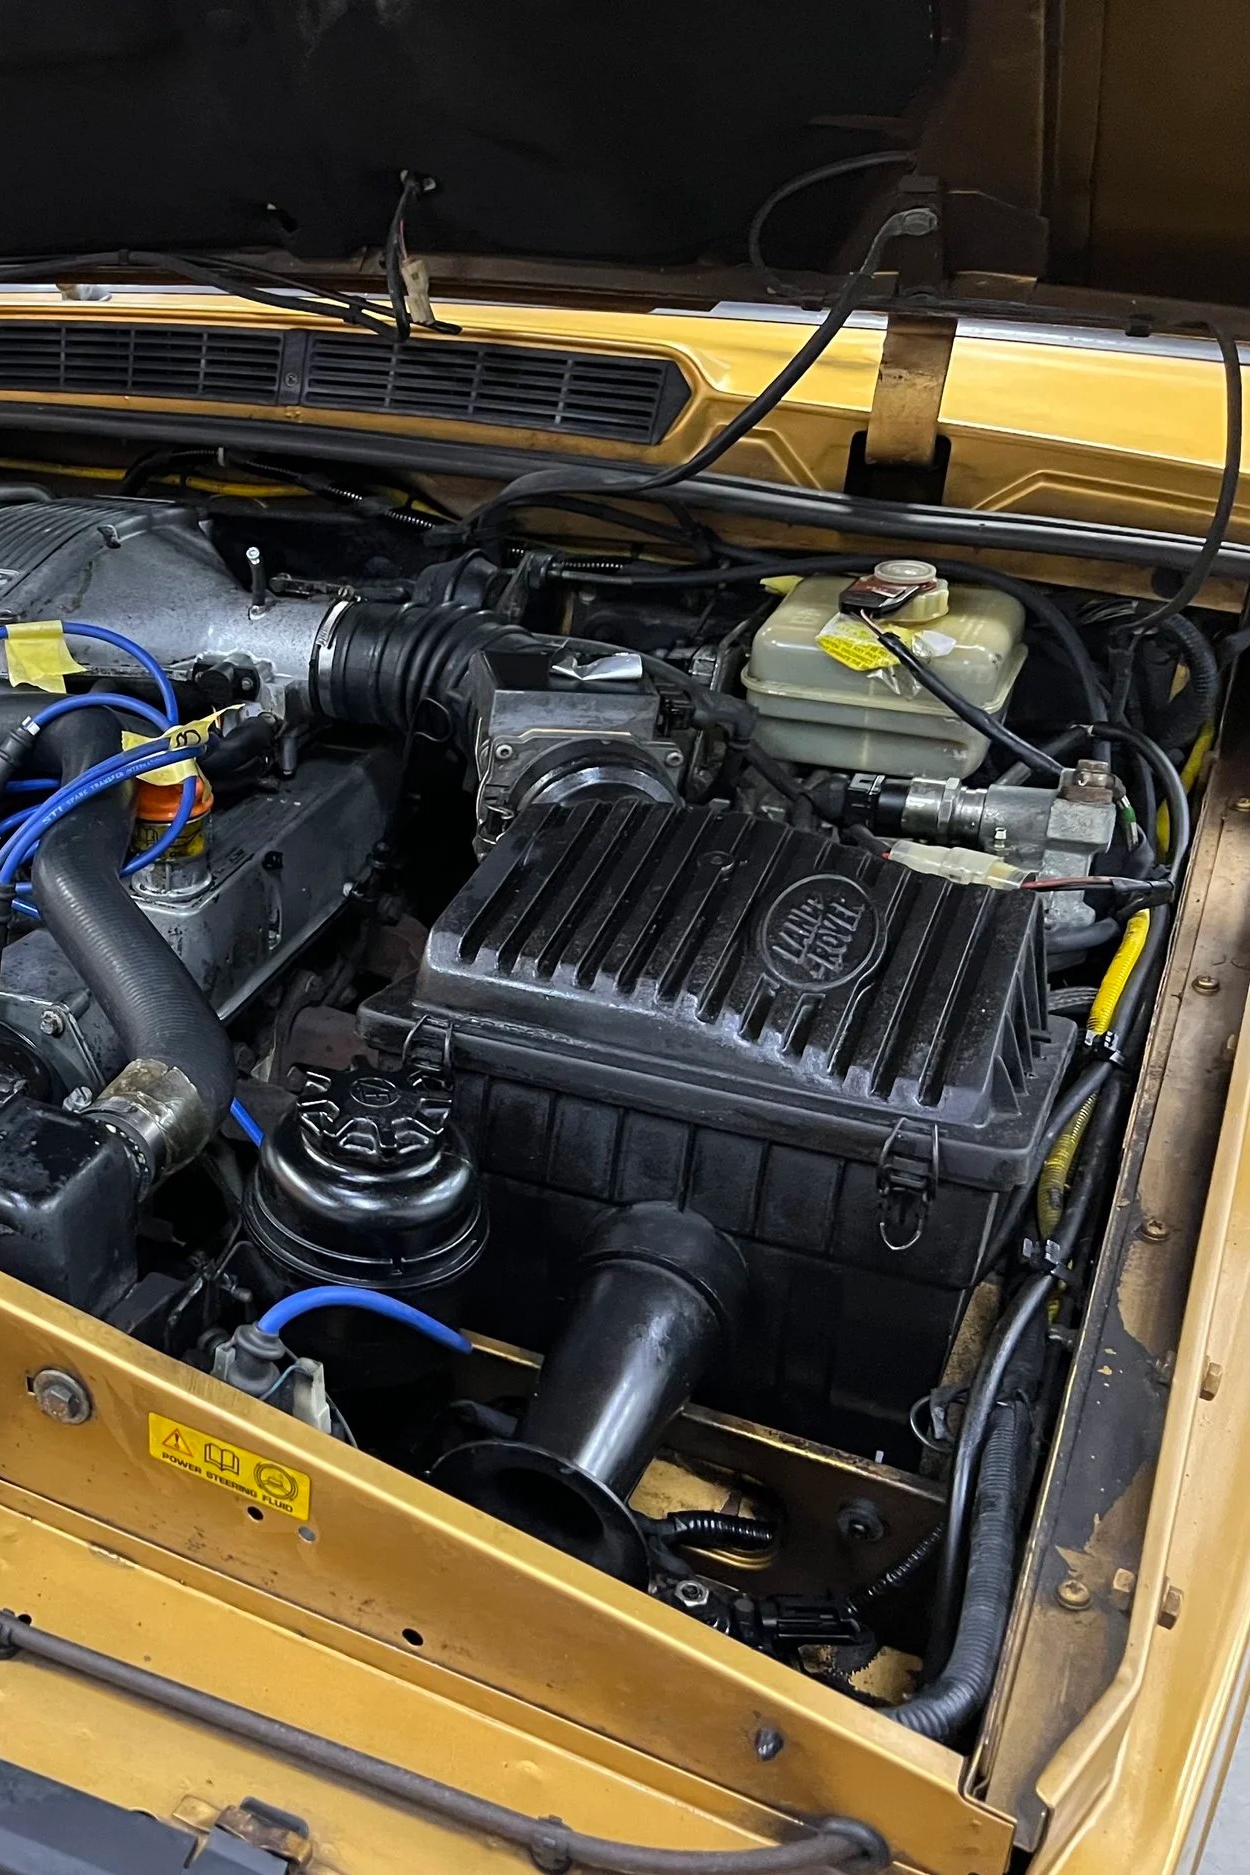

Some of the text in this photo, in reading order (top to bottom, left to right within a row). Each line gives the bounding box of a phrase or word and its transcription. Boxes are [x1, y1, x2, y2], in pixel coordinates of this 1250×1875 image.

[161, 1452, 293, 1513] POWER STEERING FLUID
